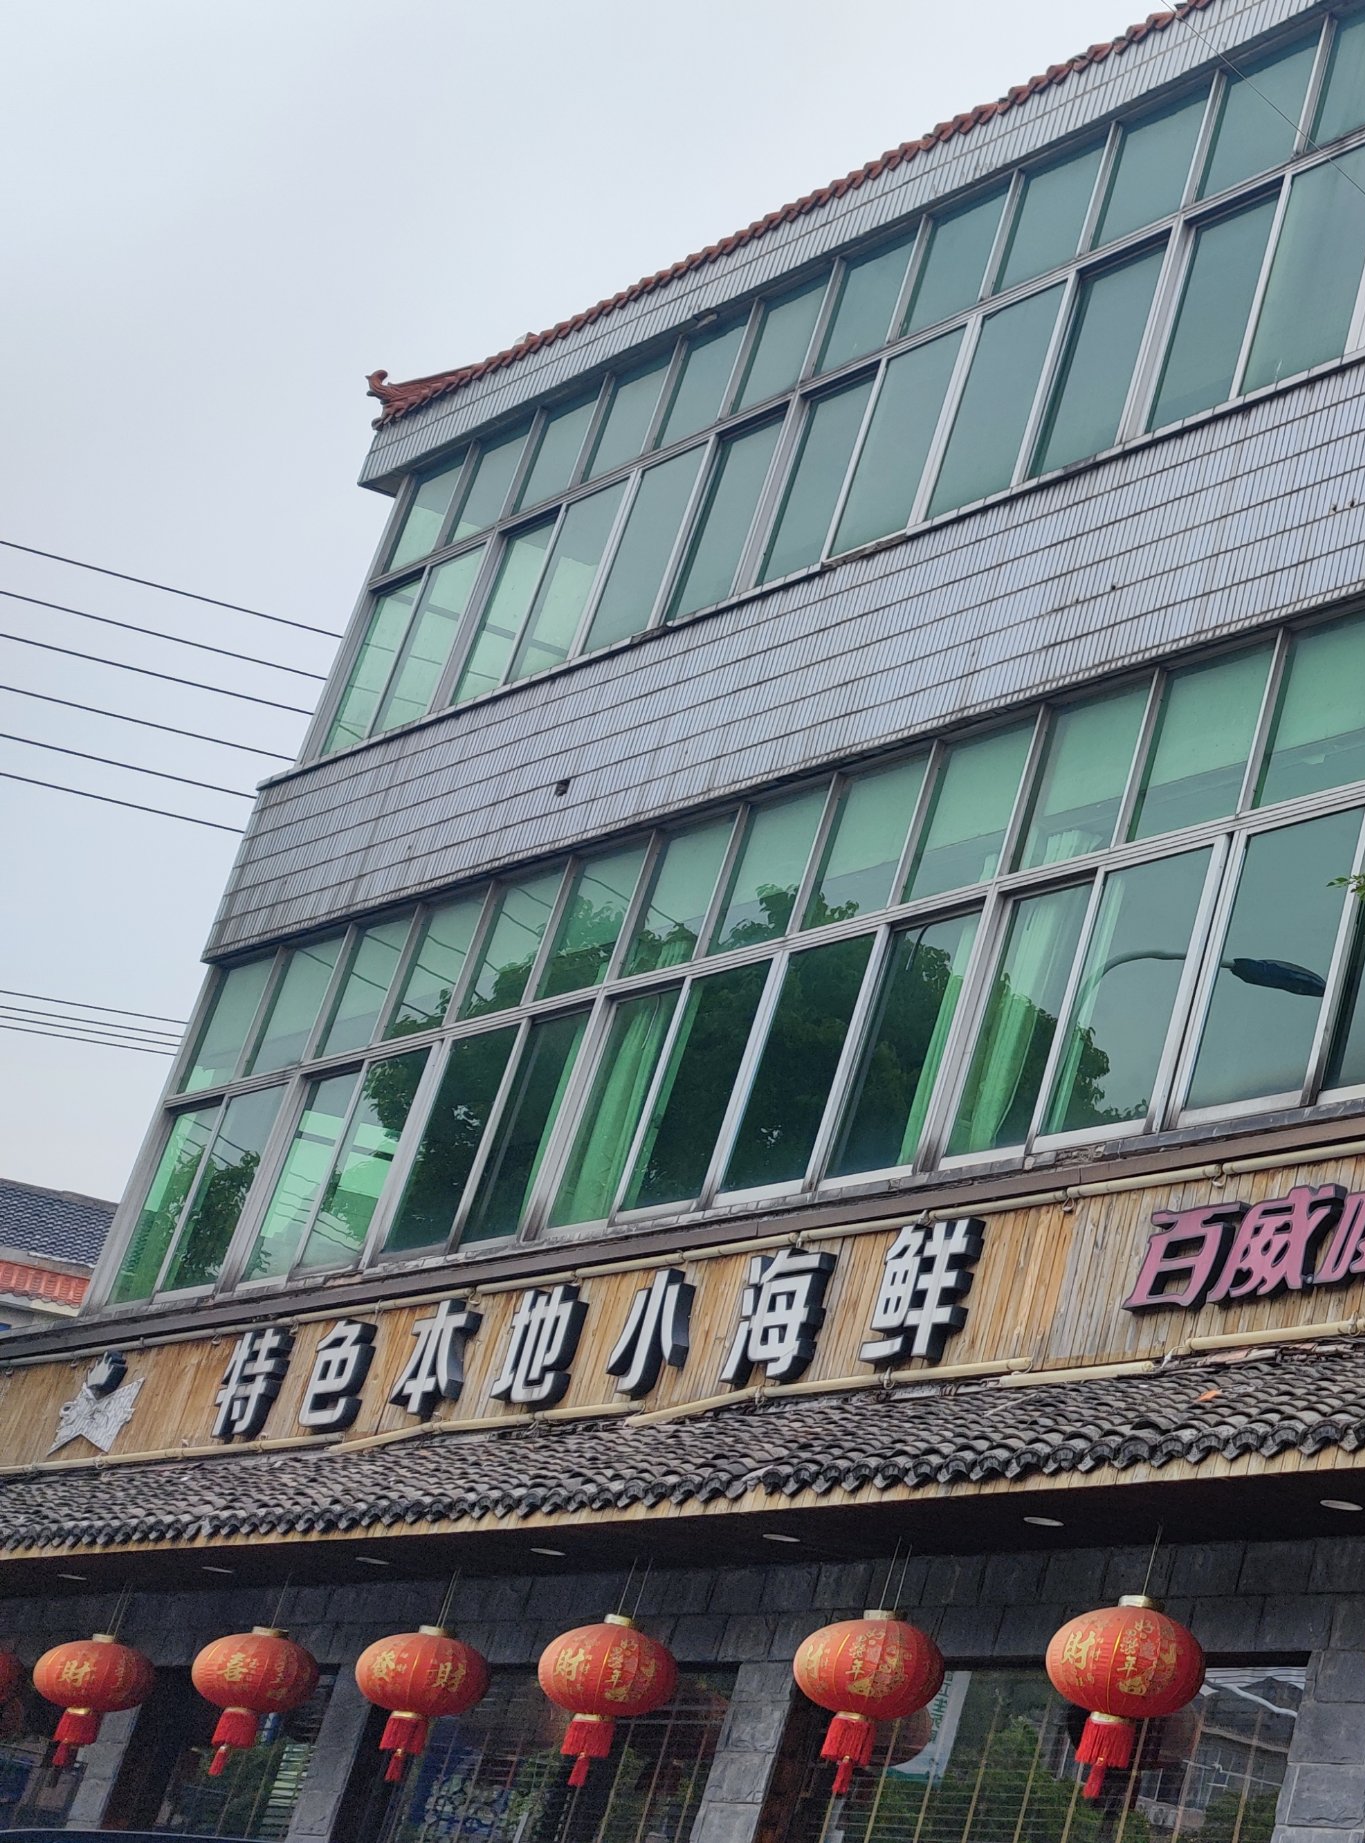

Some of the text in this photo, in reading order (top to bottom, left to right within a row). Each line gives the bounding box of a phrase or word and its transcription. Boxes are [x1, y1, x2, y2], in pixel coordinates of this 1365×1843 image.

[211, 1219, 984, 1440] 特色本地小海鲜
